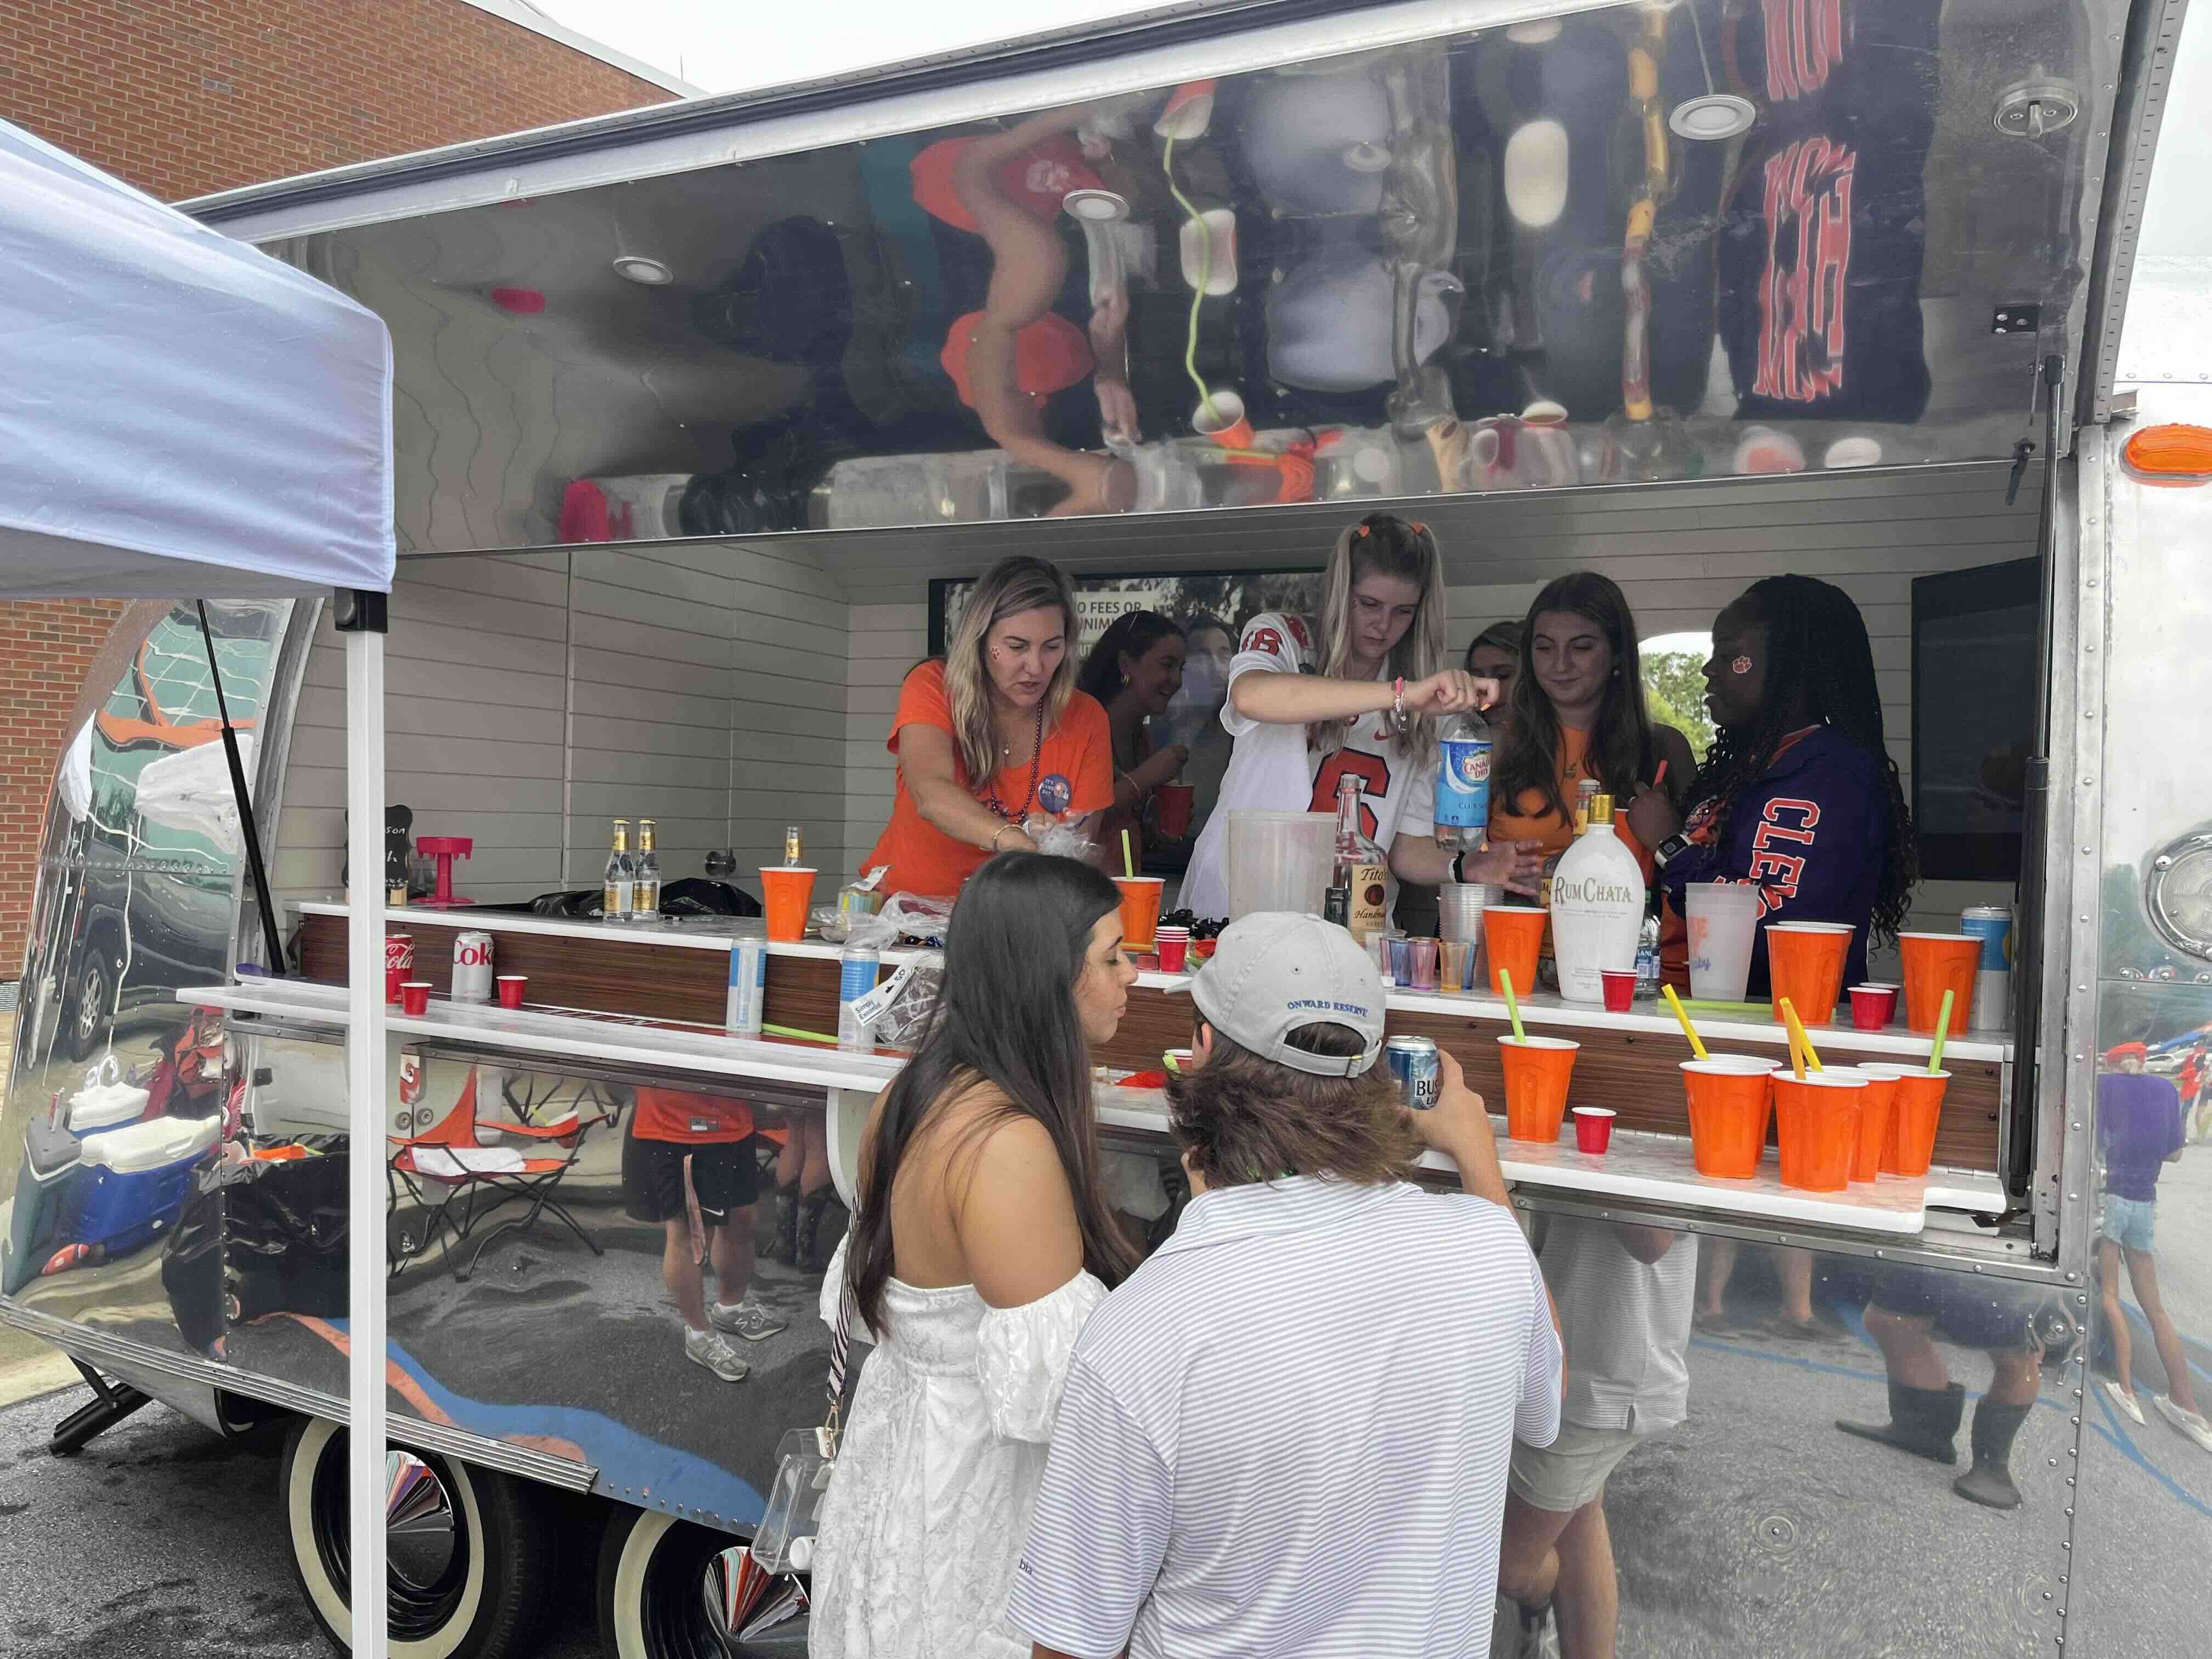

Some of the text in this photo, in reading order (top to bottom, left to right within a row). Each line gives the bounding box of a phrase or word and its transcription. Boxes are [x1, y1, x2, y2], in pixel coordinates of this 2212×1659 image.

[1090, 602, 1120, 613] FEES
[1124, 602, 1141, 613] OR
[1463, 758, 1492, 772] CANAD
[1474, 769, 1489, 778] DRY
[454, 934, 494, 966] Cok
[1287, 1000, 1369, 1018] ONWARD RESERVE
[1414, 1079, 1440, 1097] BUS
